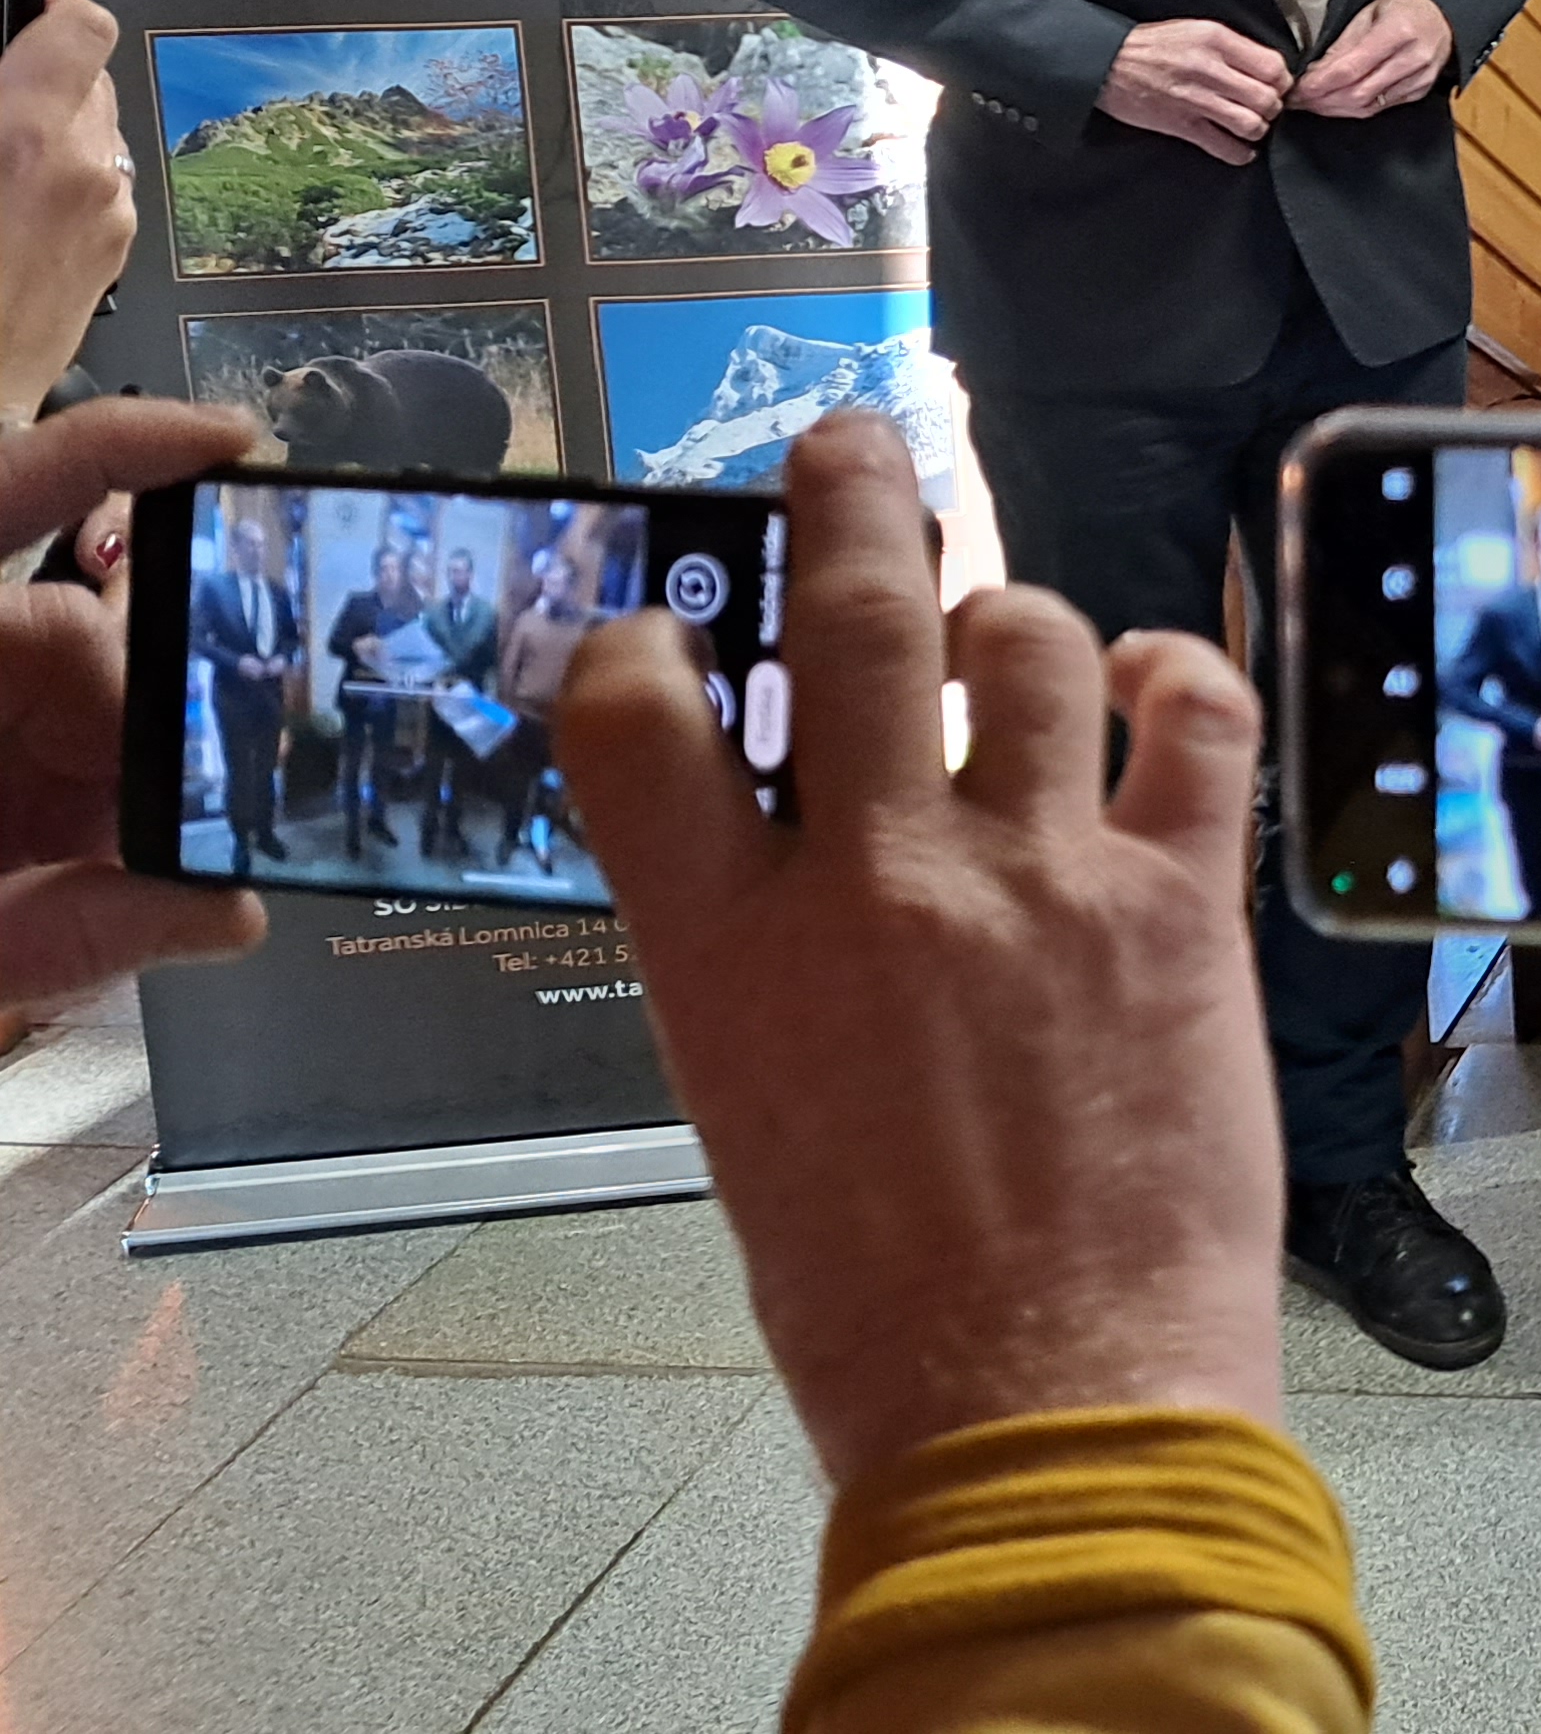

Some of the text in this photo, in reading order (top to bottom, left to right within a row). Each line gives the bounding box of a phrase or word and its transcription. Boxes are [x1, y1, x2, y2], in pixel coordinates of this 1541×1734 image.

[326, 918, 606, 956] Tatranská Lomnica 14
